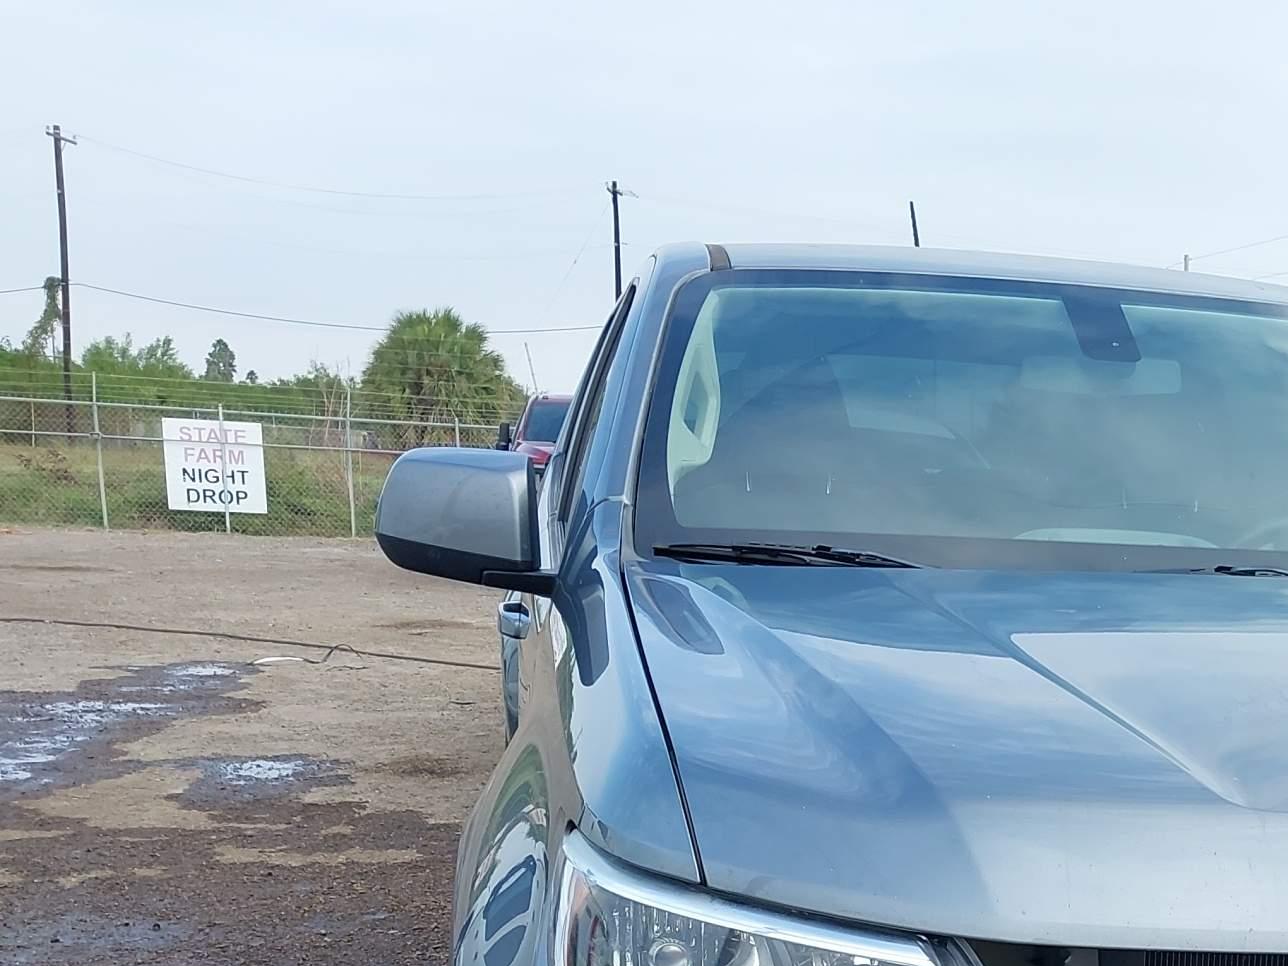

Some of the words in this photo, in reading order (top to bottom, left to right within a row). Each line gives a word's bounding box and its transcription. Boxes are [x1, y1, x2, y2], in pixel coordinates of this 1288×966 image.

[179, 426, 247, 444] STATE
[183, 447, 245, 465] FARM
[182, 467, 249, 485] NIGHT
[186, 488, 248, 505] DROP
